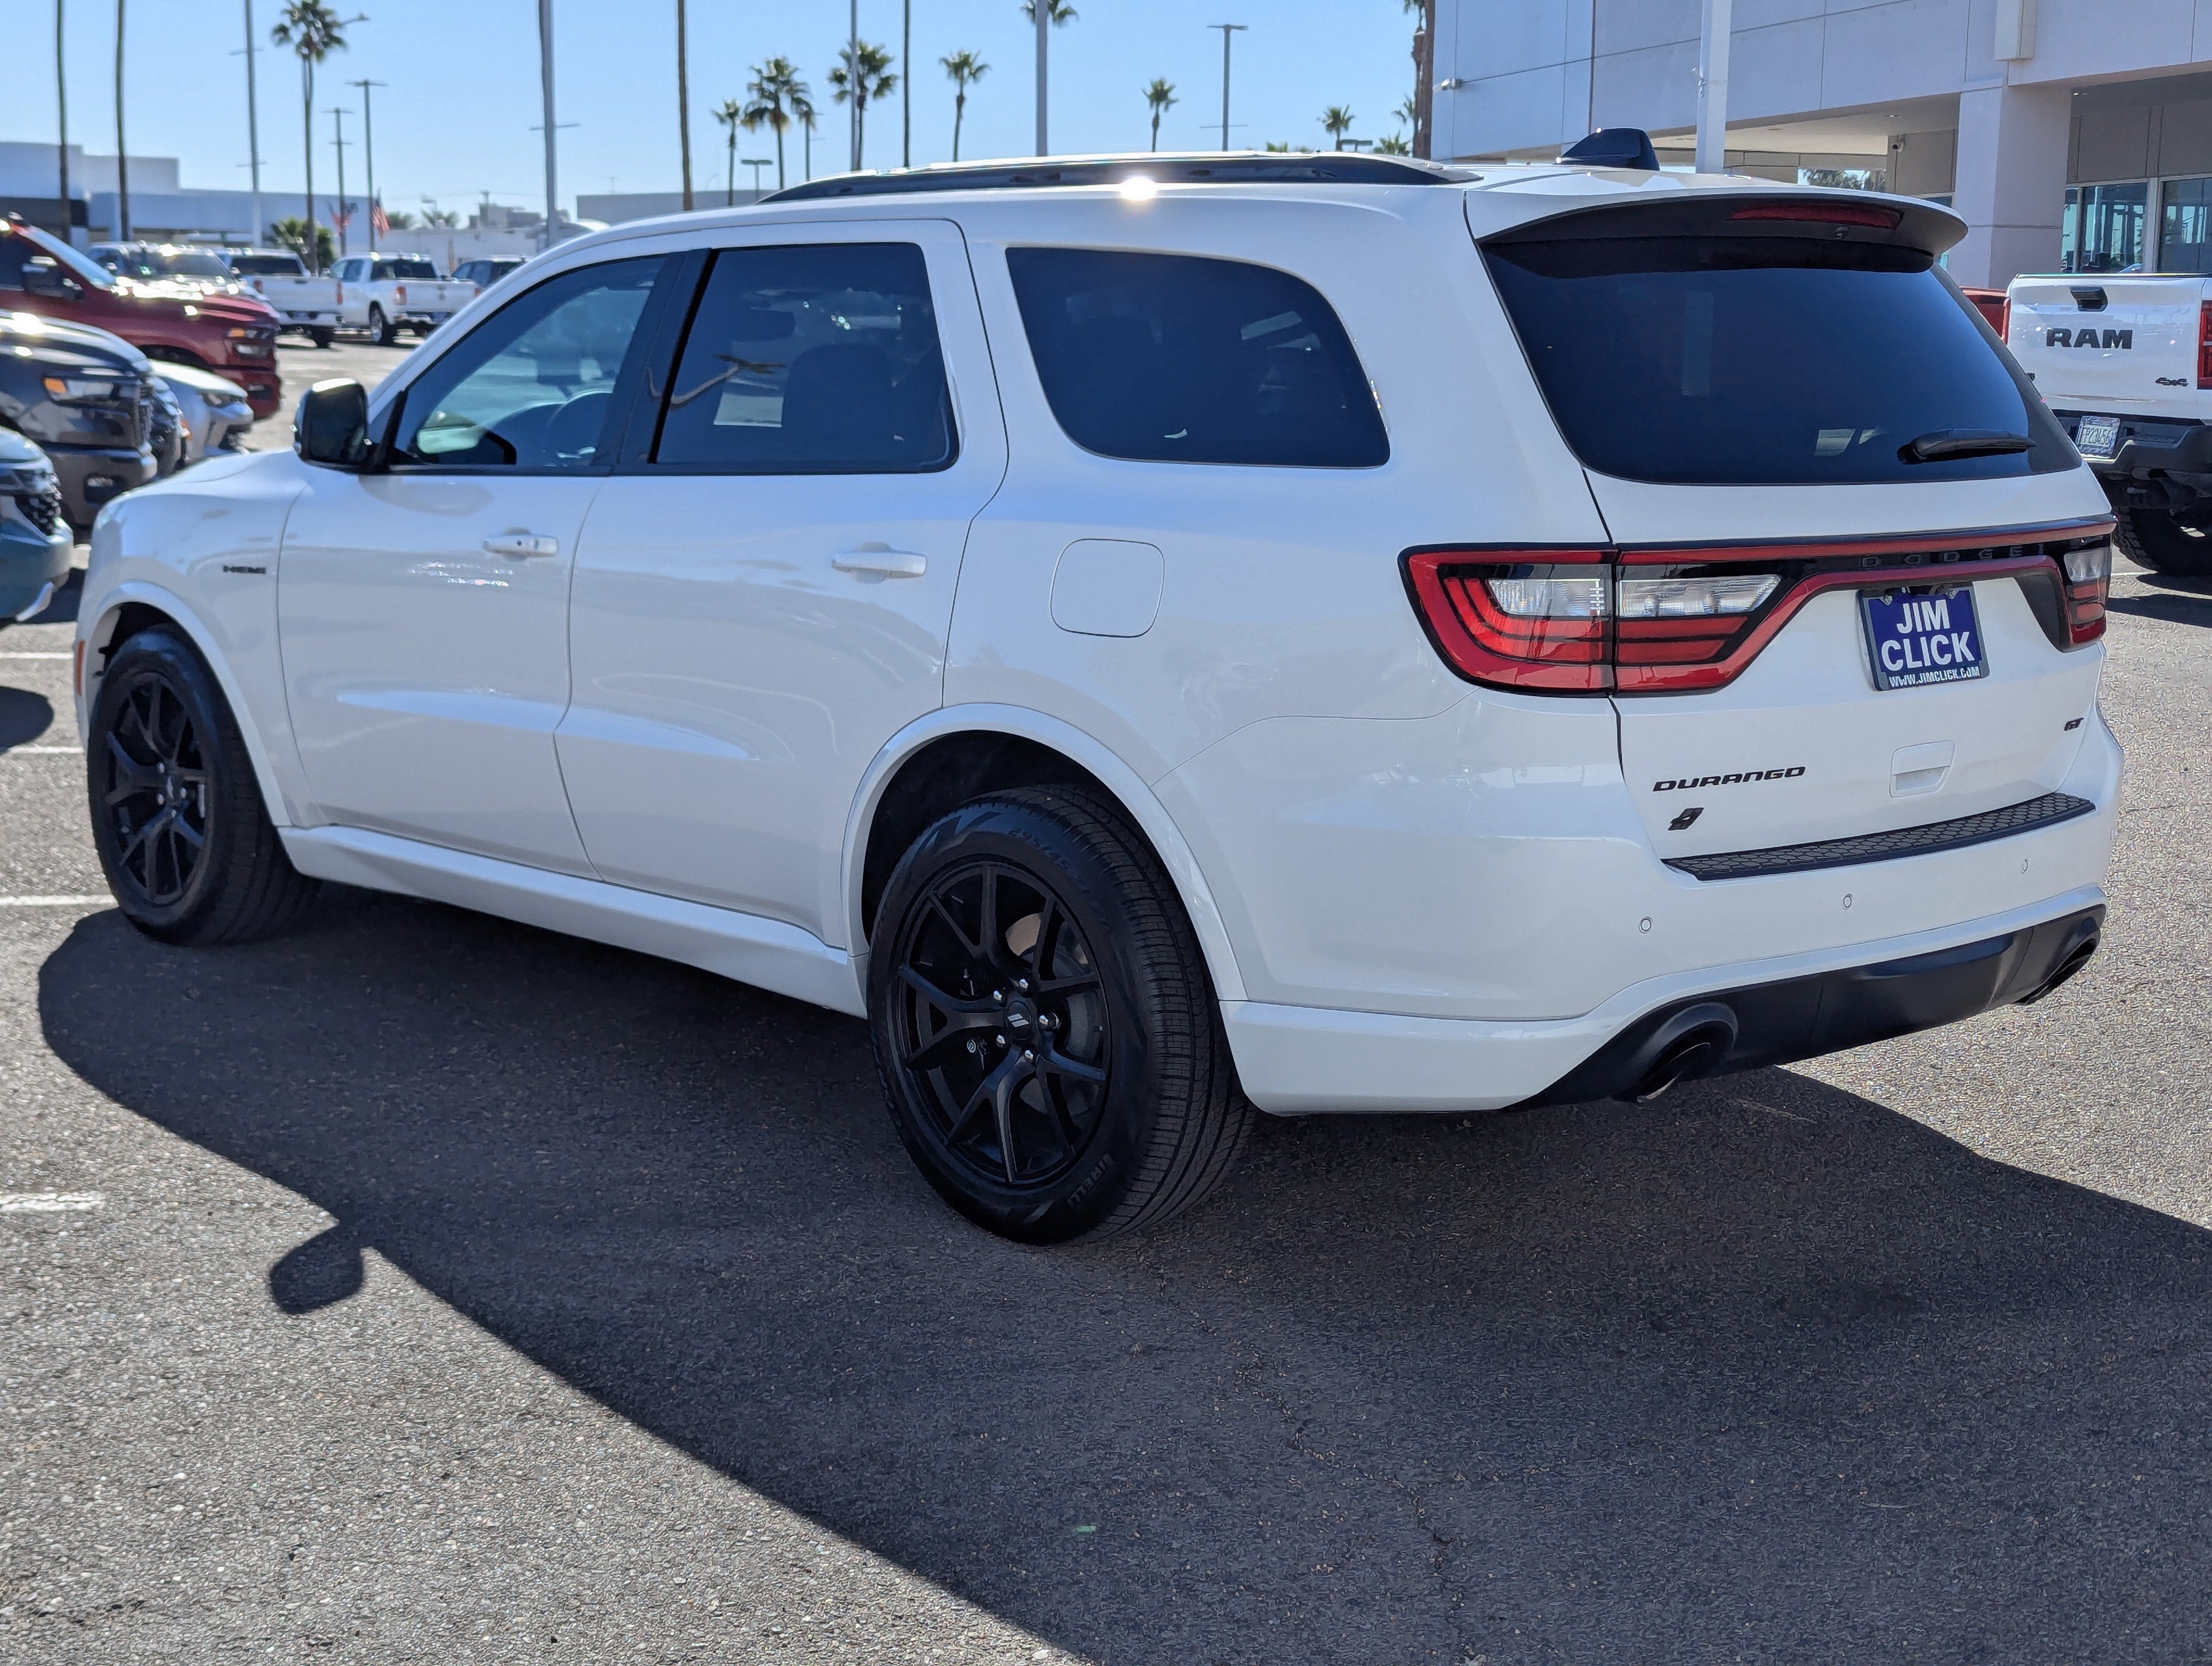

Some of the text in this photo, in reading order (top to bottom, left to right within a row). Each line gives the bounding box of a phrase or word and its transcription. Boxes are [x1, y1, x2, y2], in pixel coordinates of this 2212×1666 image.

[2046, 328, 2133, 349] RAM
[1862, 546, 2022, 567] DODGE
[1896, 599, 1950, 633] JIM
[1881, 631, 1975, 671] CLICK
[1889, 666, 1980, 687] WWW.JIMCLICK.COM
[1652, 766, 1805, 792] DURANGO
